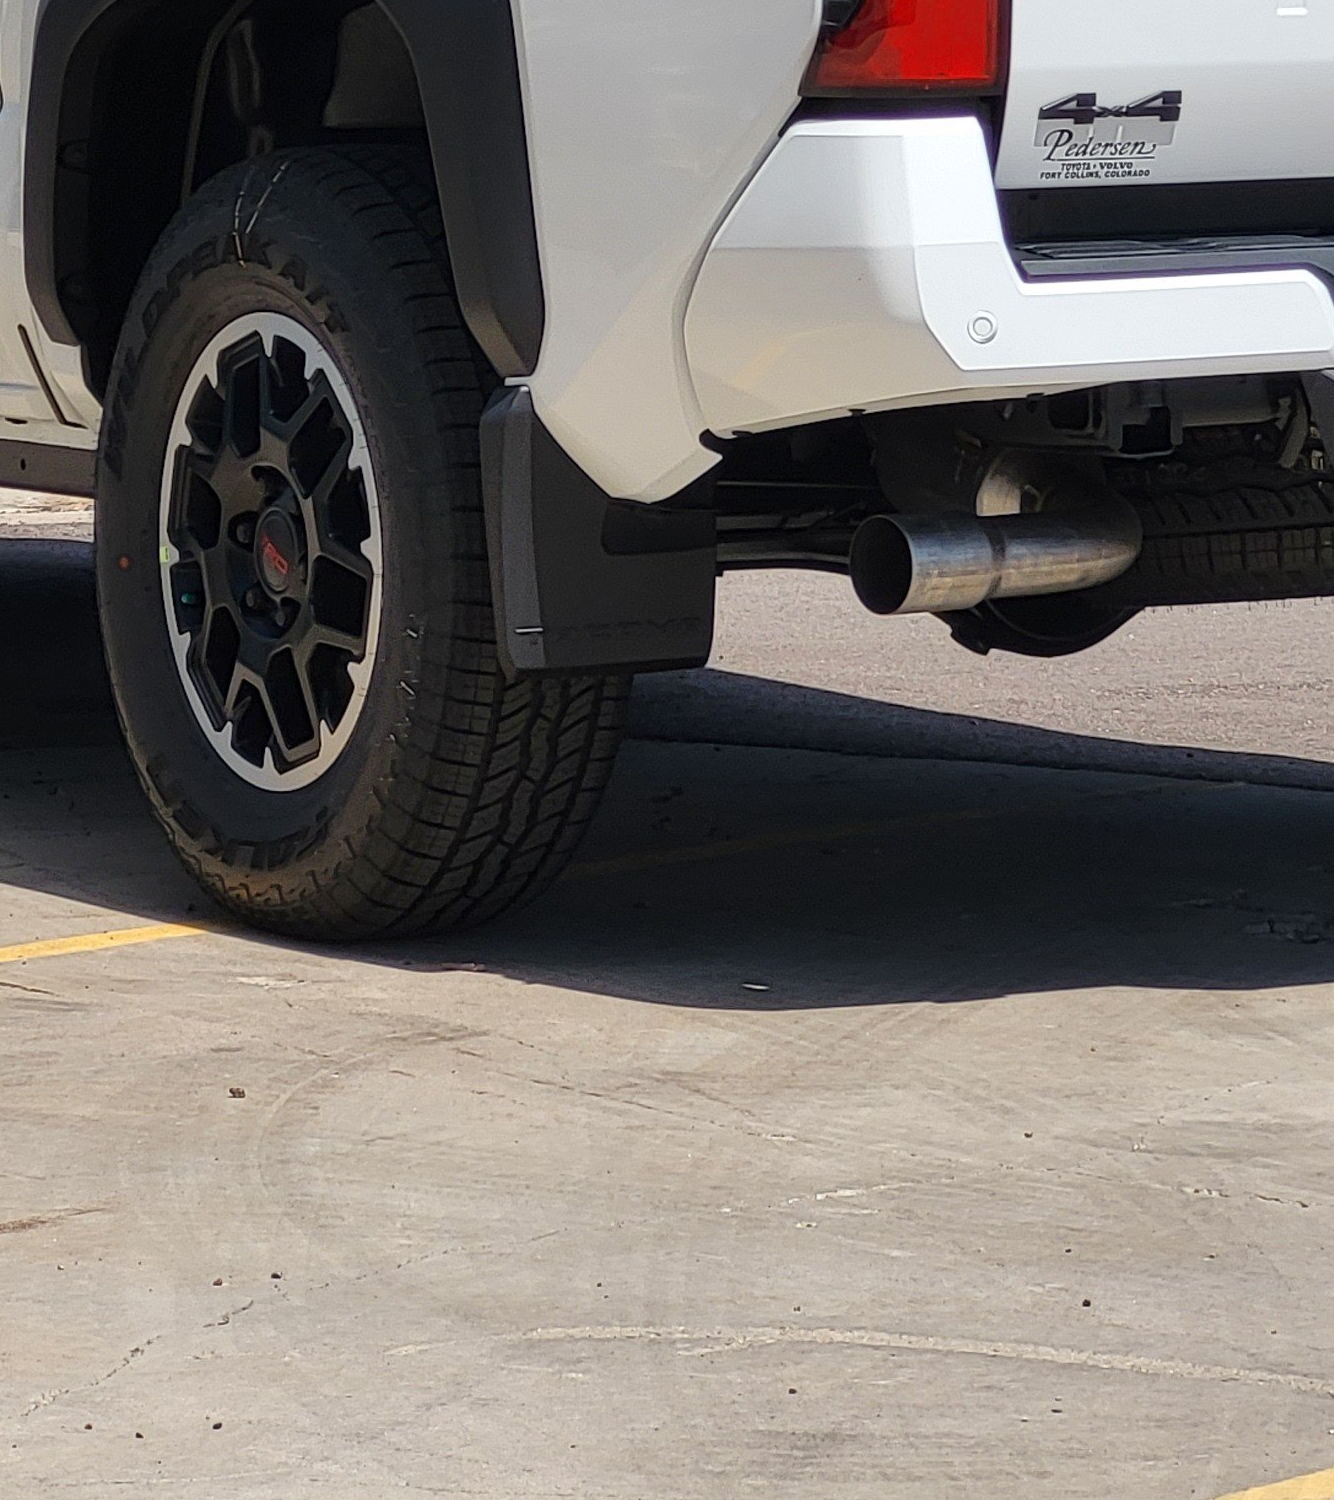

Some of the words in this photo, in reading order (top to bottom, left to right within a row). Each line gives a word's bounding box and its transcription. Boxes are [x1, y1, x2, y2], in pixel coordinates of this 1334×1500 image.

[1042, 128, 1157, 161] Pedersen
[1061, 162, 1091, 171] TOYOTA
[1099, 161, 1134, 170] VOLVO
